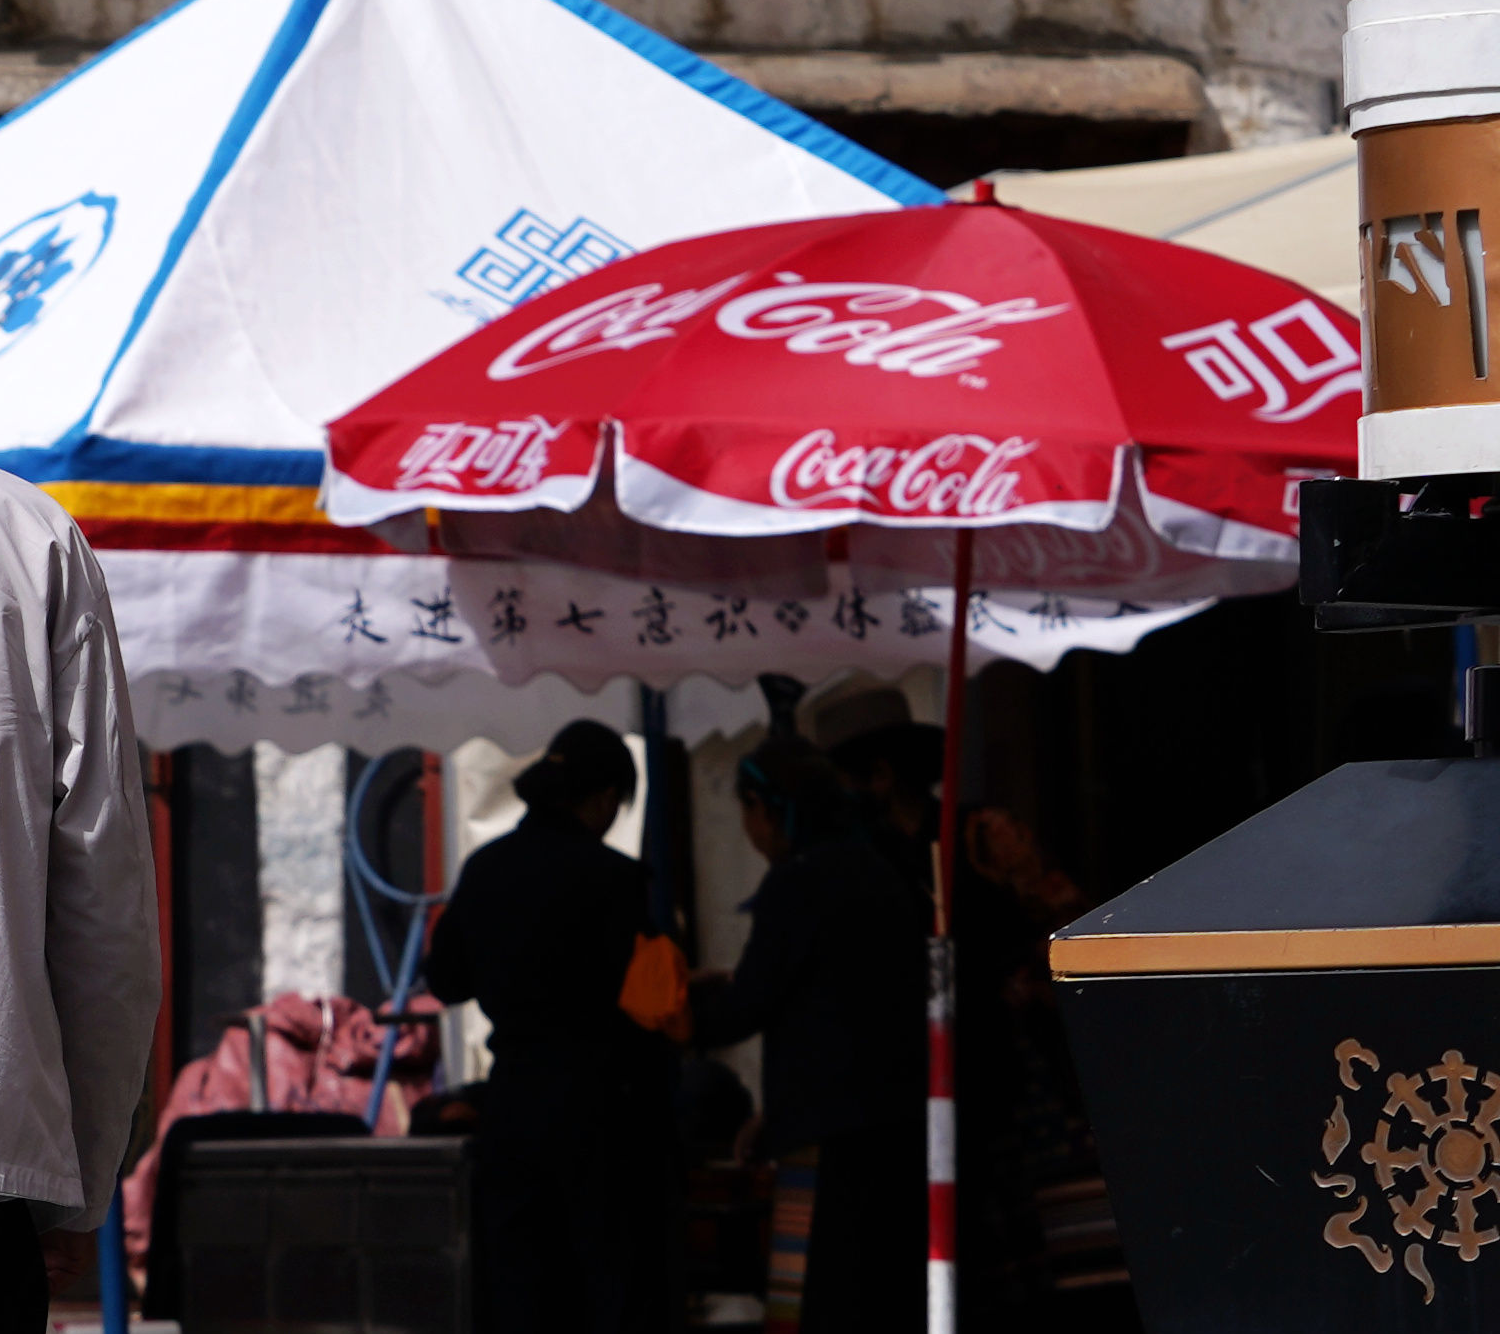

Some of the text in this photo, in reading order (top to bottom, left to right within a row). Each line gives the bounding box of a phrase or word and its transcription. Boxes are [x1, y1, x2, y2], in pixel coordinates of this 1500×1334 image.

[395, 415, 573, 490] 可口可乐
[770, 429, 1038, 515] Coca-Cola
